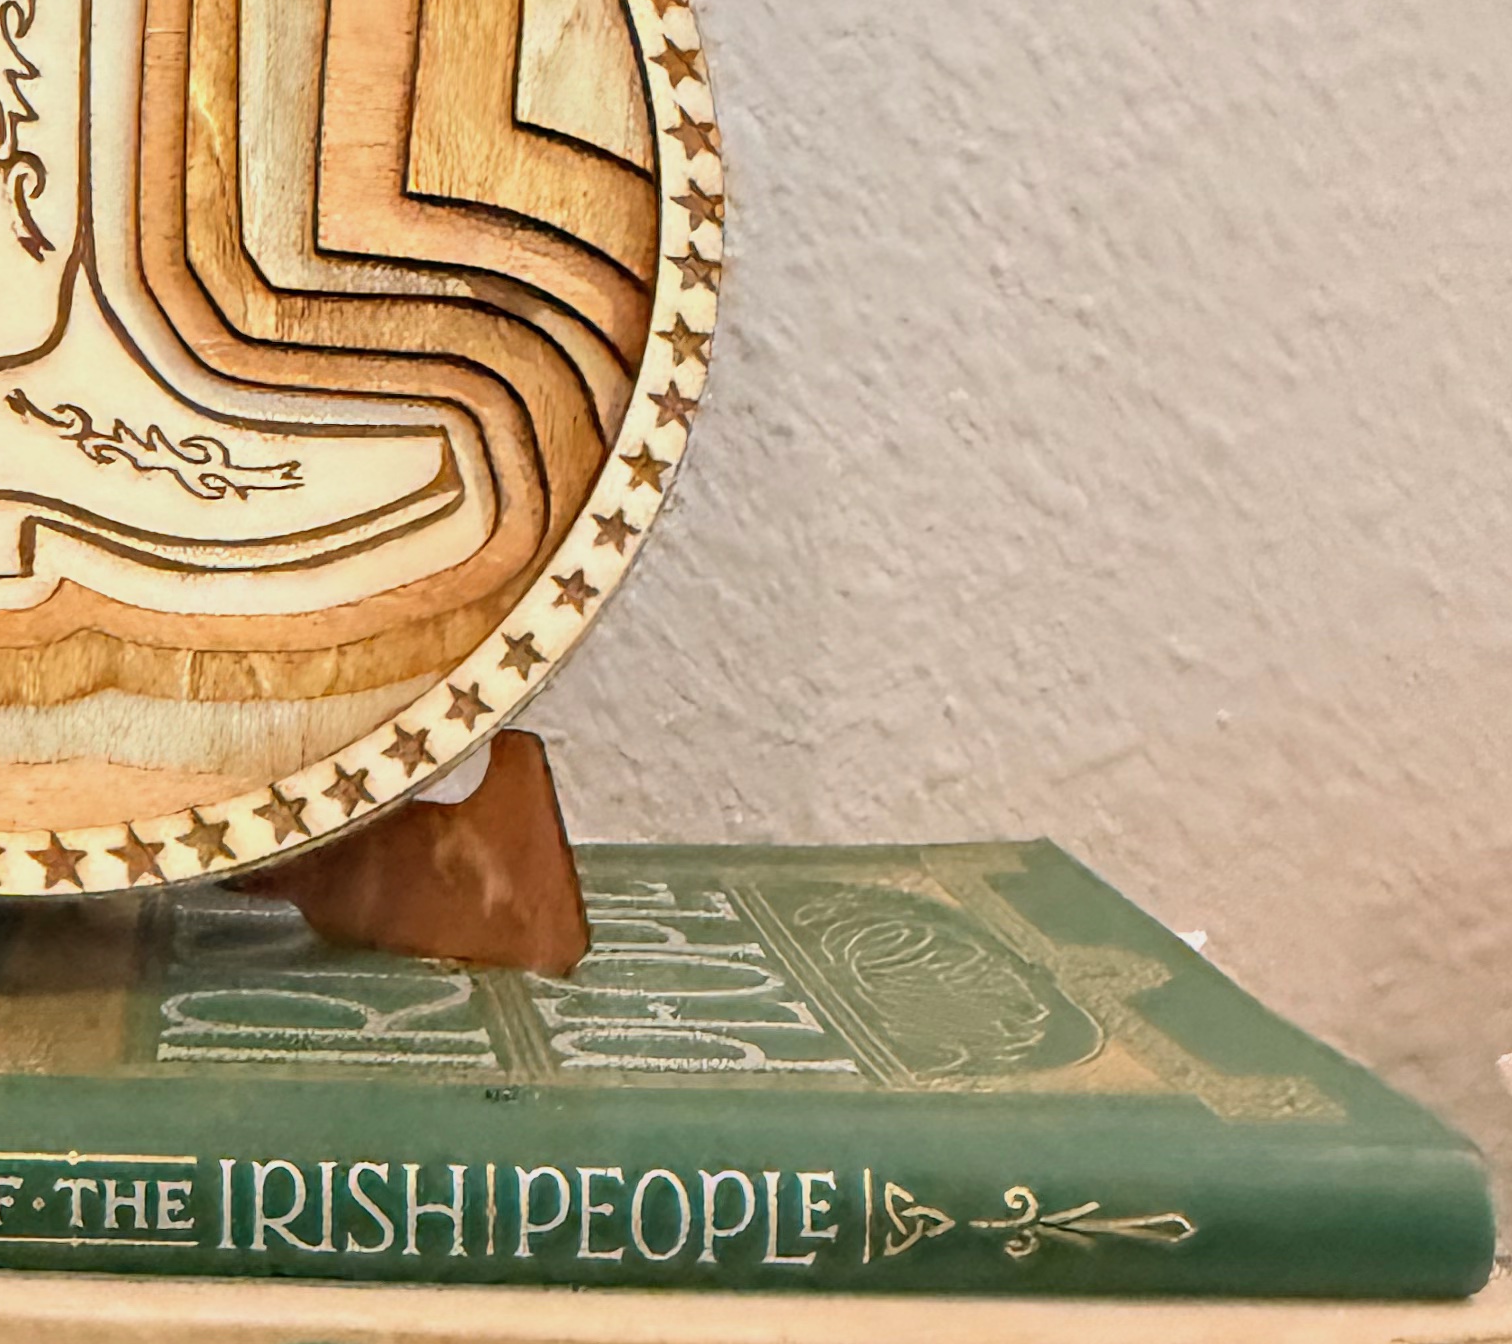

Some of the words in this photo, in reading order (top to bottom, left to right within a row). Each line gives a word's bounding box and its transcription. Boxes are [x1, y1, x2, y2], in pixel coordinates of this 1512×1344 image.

[52, 1177, 195, 1230] THE
[215, 1157, 470, 1257] IRISH
[514, 1164, 839, 1265] PEOPLE
